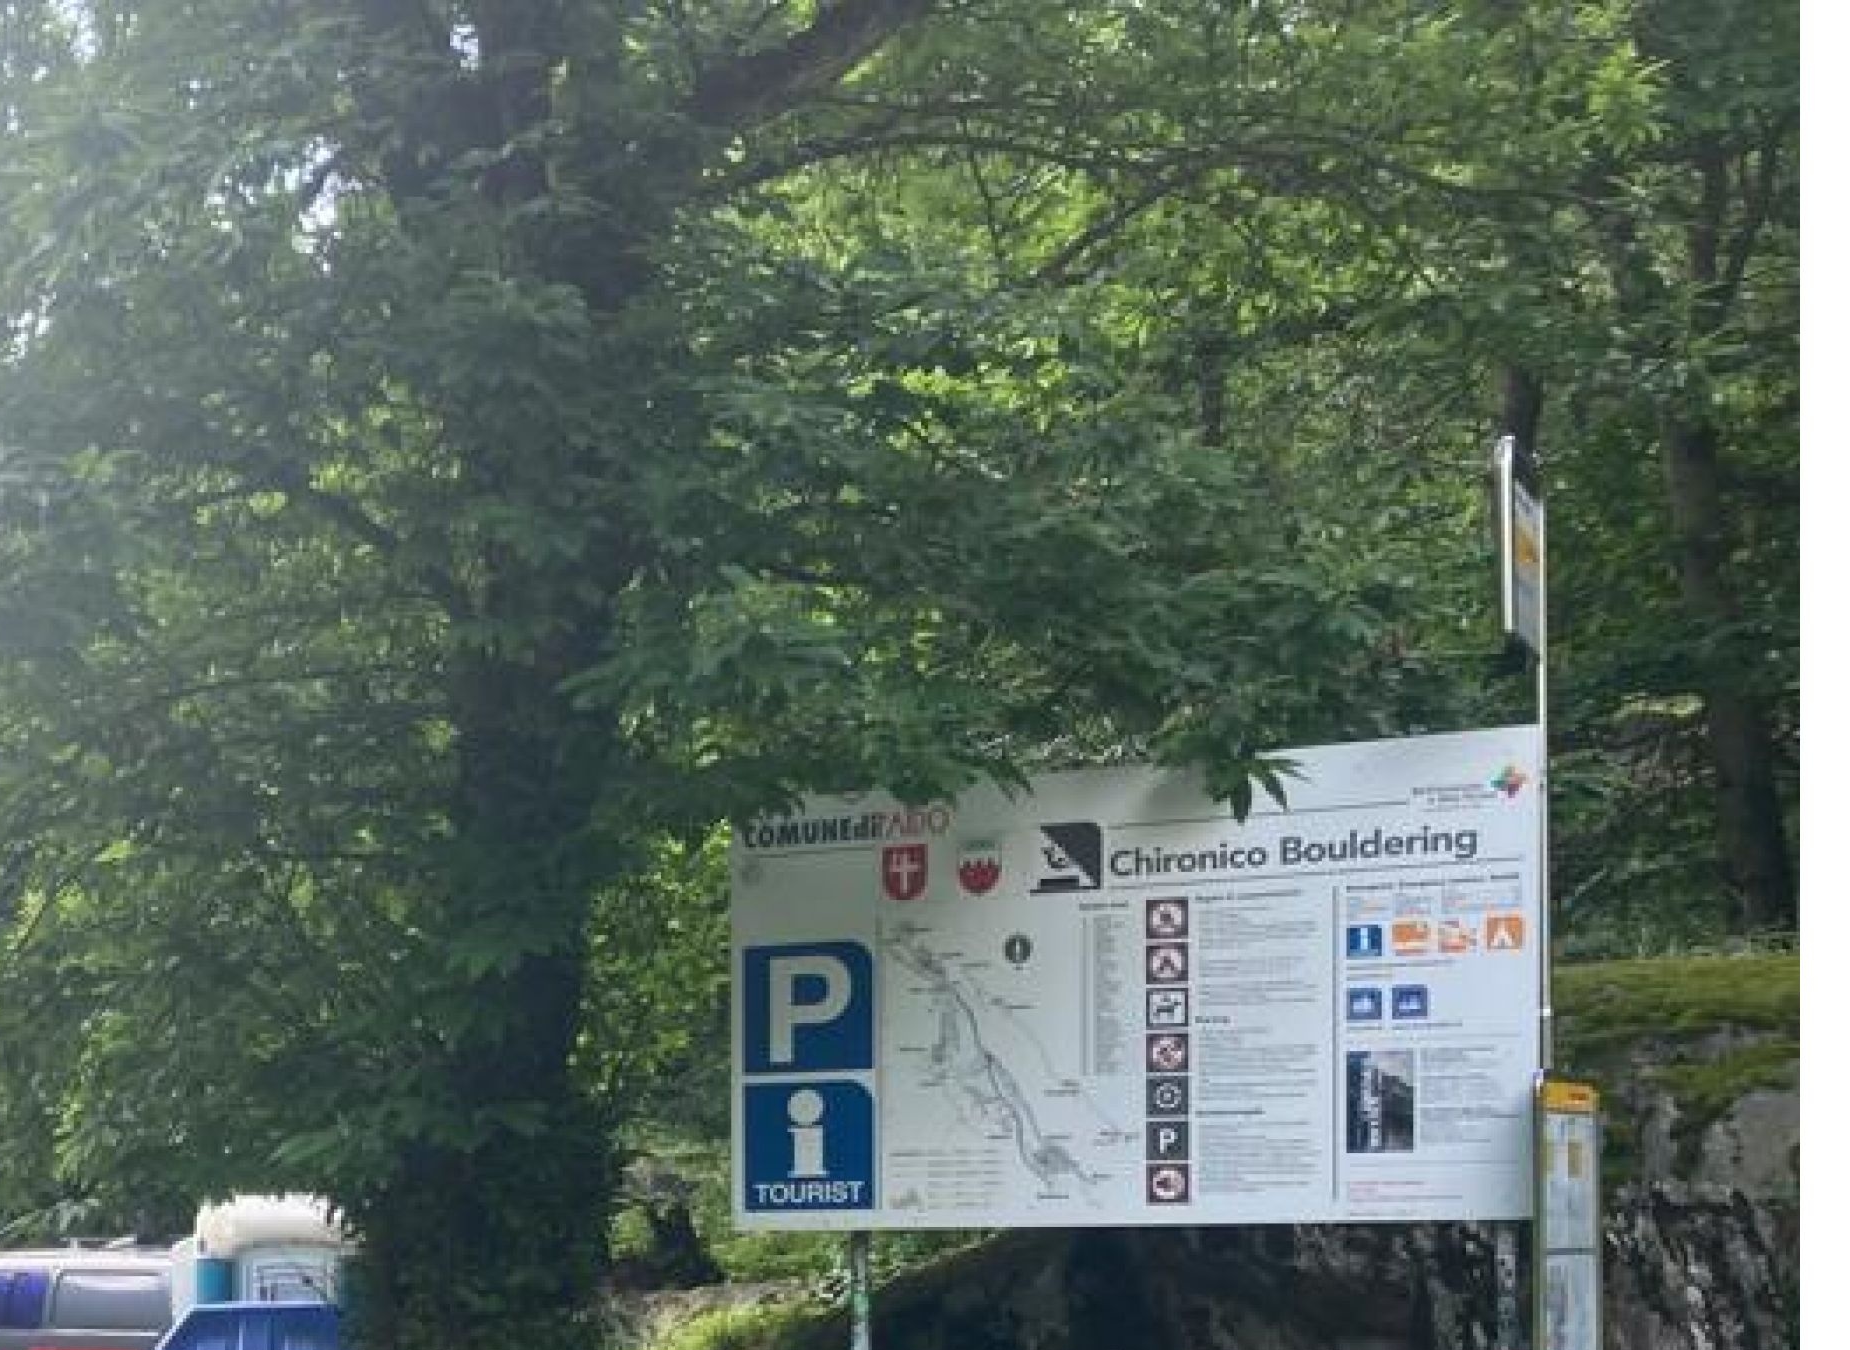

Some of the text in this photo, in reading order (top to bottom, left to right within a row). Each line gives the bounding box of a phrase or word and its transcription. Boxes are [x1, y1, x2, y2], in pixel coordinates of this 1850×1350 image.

[1109, 825, 1478, 876] Chironico Bouldering
[770, 956, 851, 1063] P
[752, 1182, 865, 1203] TOURIST
